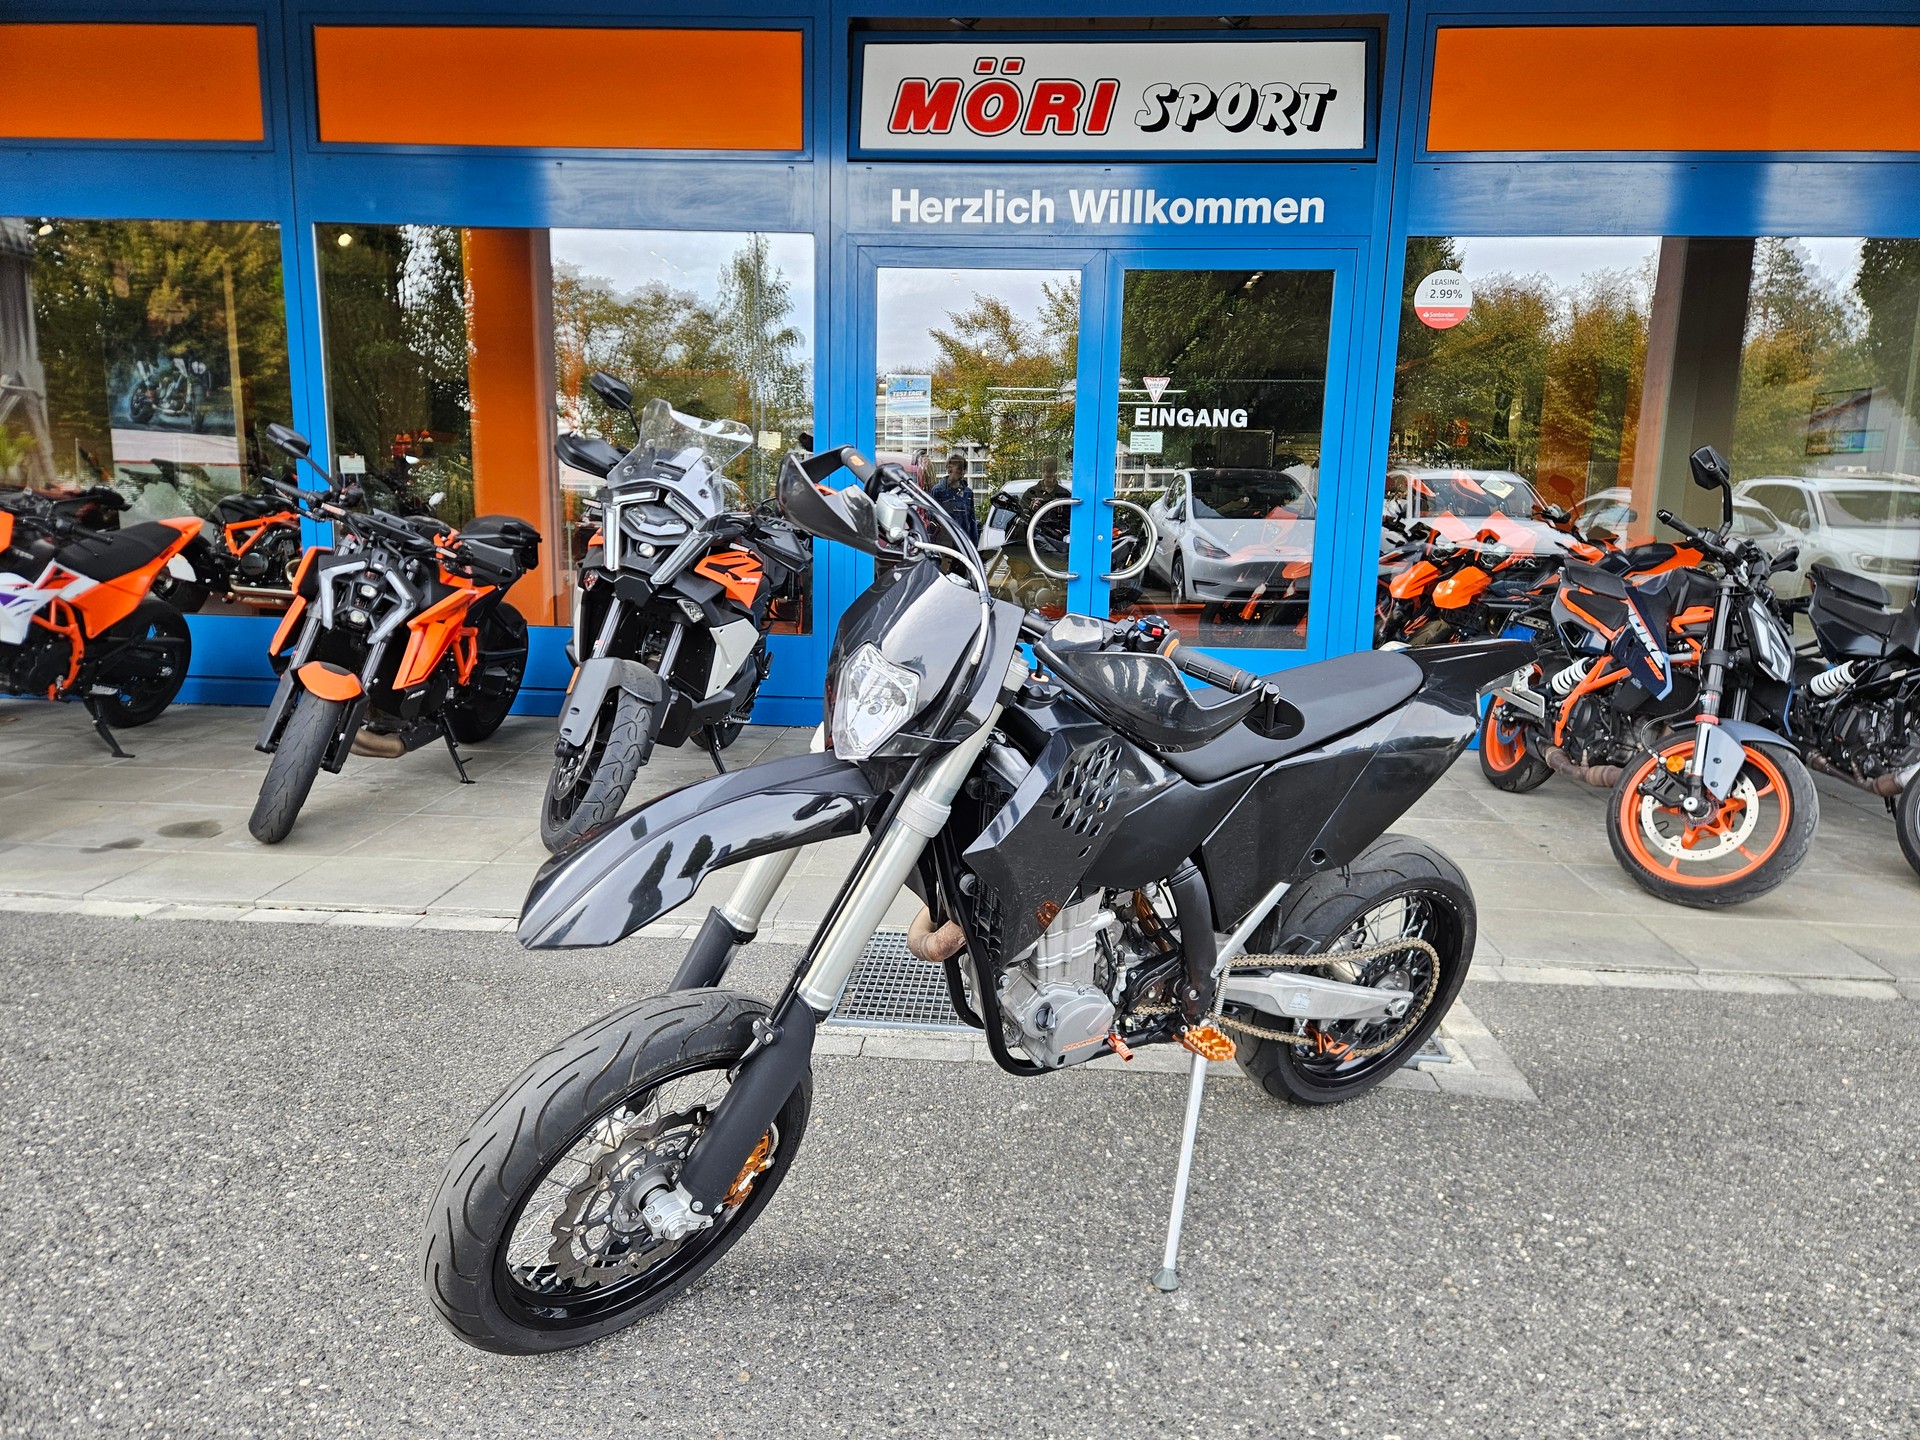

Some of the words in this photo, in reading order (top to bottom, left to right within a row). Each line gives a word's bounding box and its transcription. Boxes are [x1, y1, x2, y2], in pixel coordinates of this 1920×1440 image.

[887, 57, 1120, 136] MÖRI
[1134, 82, 1338, 135] SPORT
[891, 188, 1055, 225] Herzlich
[1069, 188, 1326, 225] Willkommen
[1430, 289, 1463, 298] 2.99%
[1135, 407, 1248, 427] EINGANG
